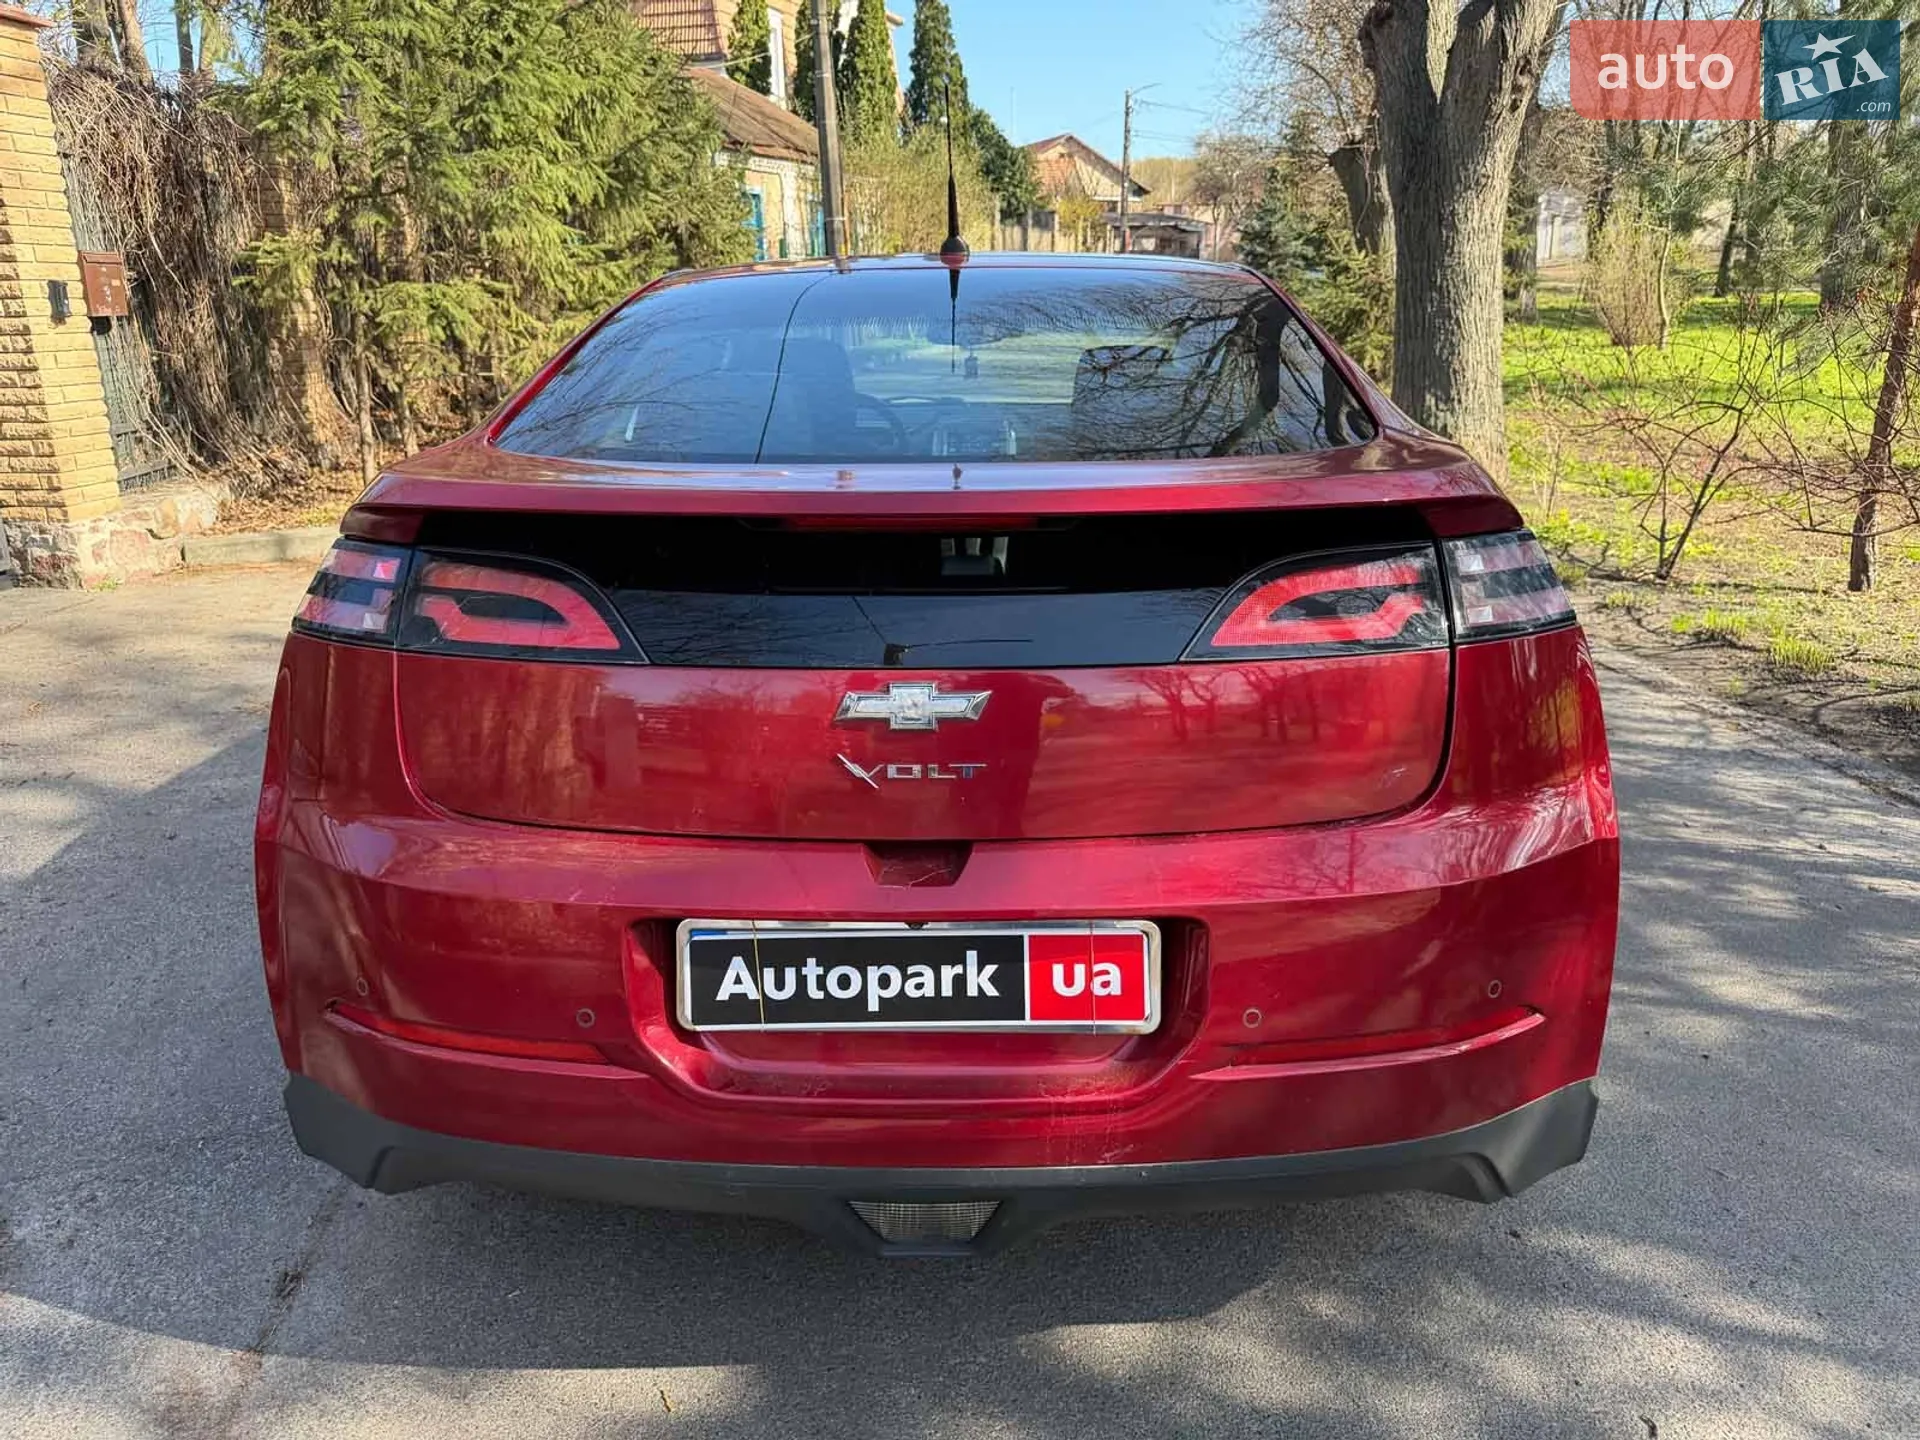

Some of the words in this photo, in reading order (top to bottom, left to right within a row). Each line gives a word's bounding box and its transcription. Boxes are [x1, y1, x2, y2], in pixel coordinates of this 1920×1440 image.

[837, 753, 988, 789] VOLT
[715, 950, 1000, 1012] Autopark
[1050, 961, 1123, 997] ua
